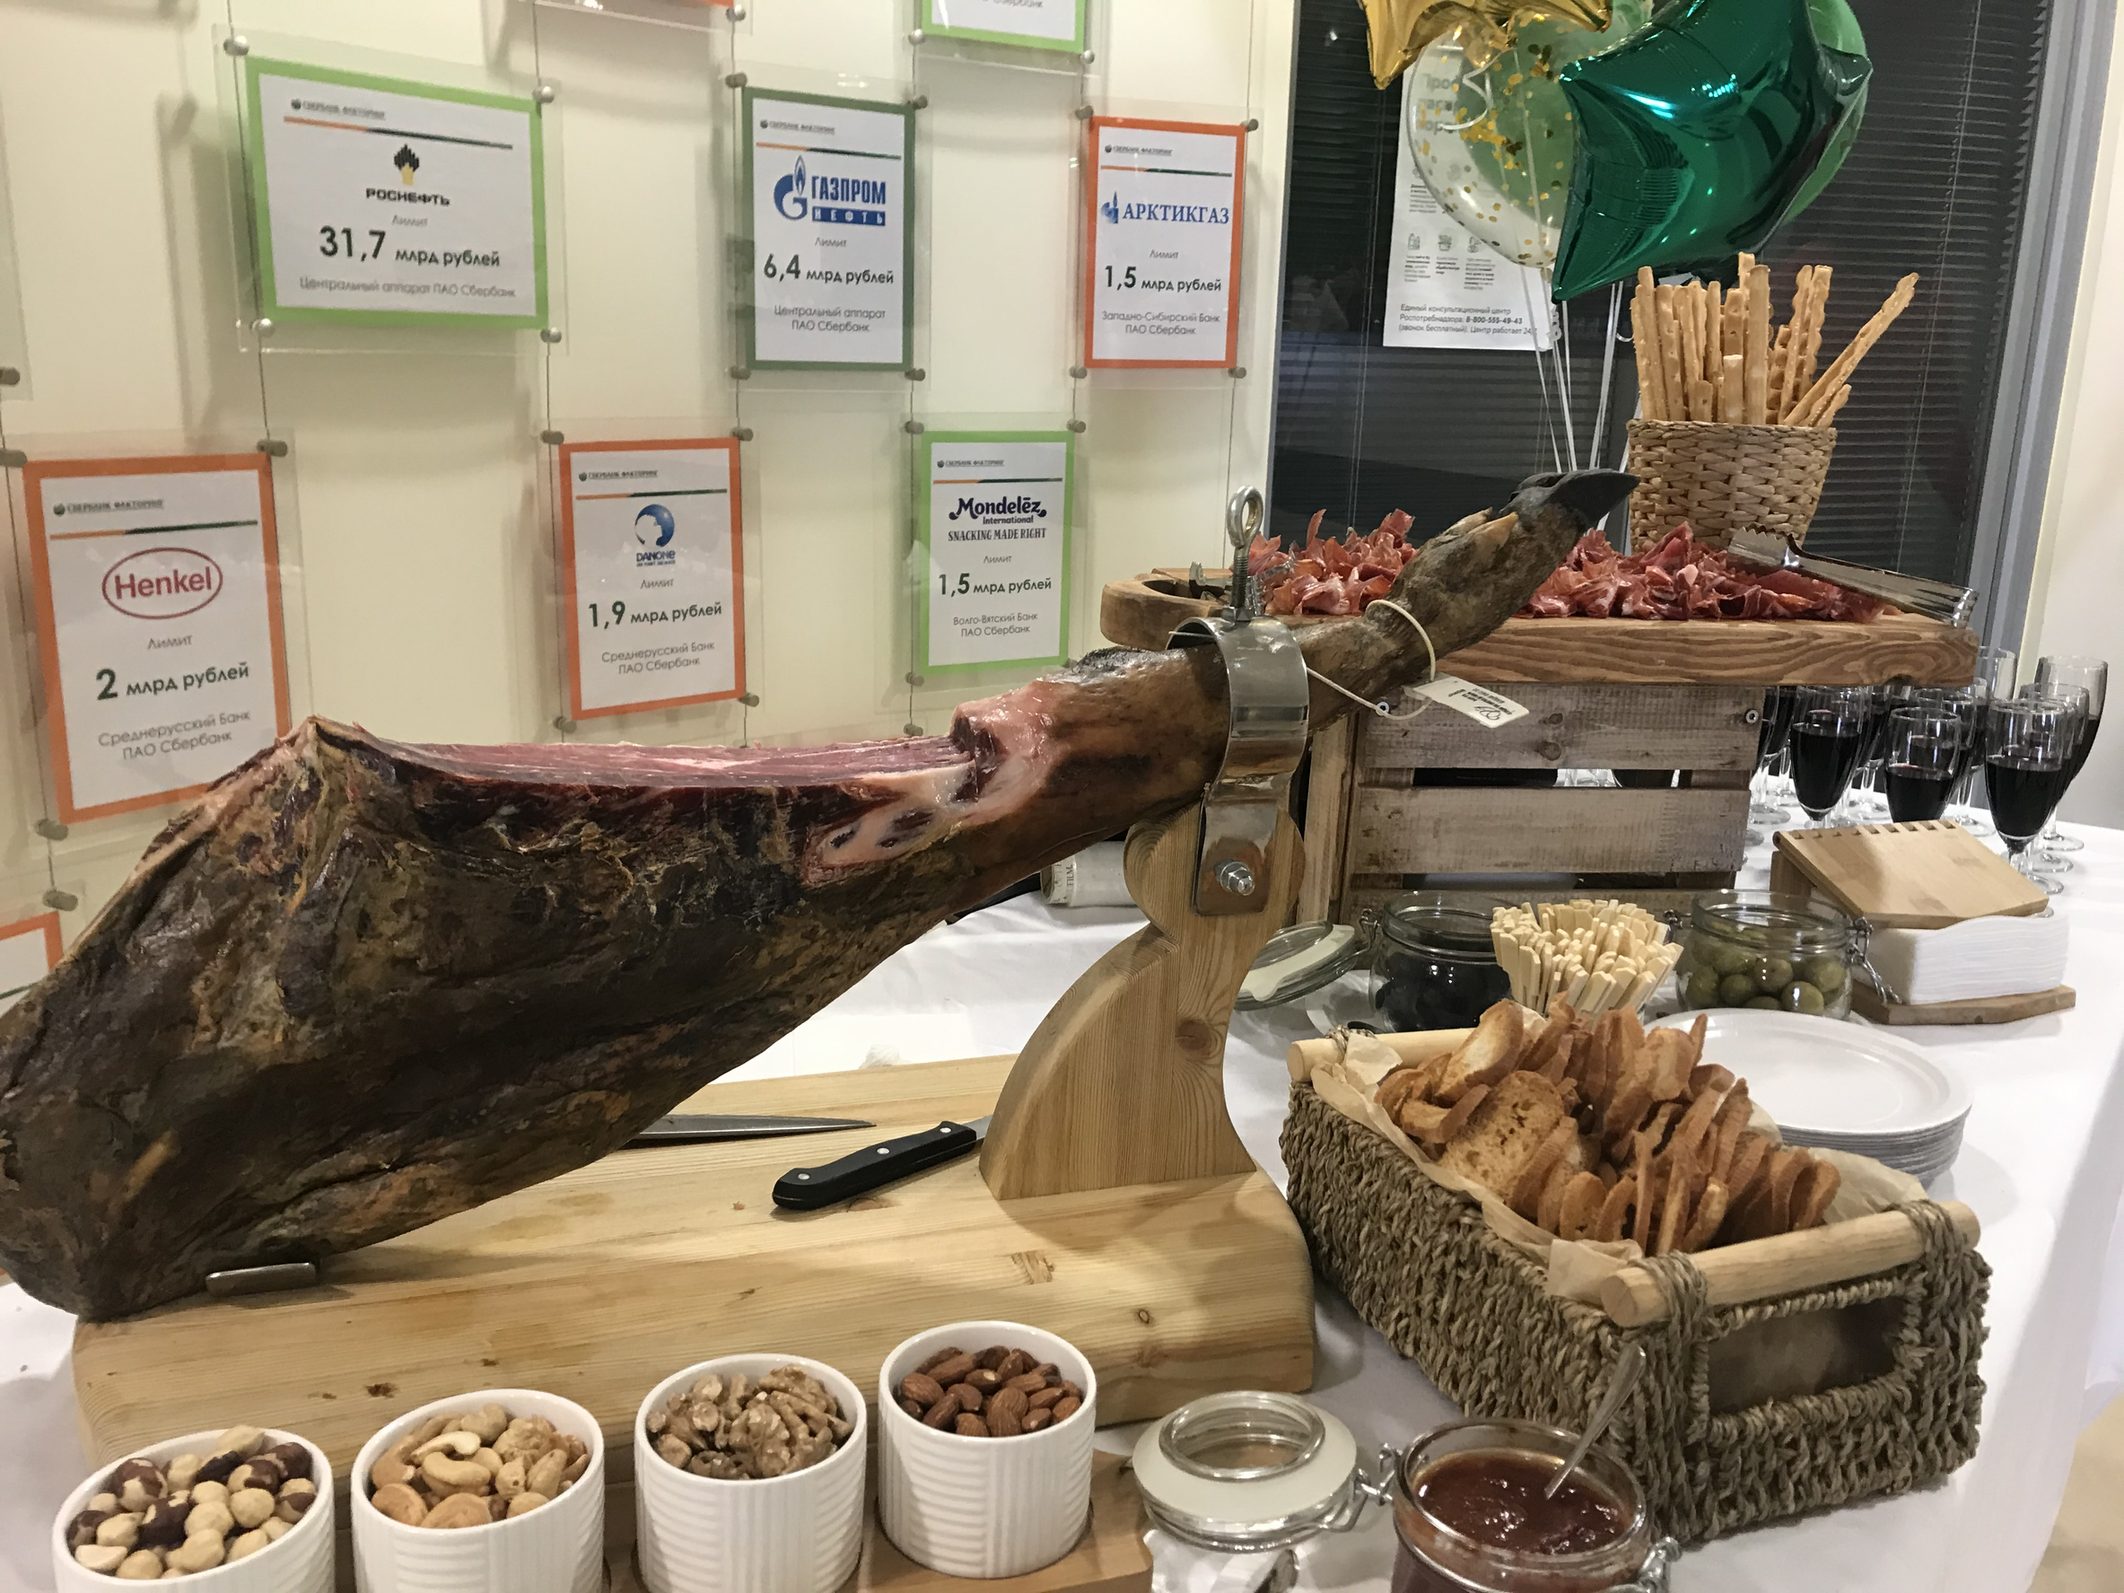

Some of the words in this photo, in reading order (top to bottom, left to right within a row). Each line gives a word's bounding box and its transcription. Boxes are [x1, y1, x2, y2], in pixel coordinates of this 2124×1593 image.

[366, 188, 450, 206] РОСНЕФТЬ
[811, 175, 886, 205] ГАЗПРОМ
[392, 214, 428, 228] Лимит
[813, 208, 884, 225] НЕФТЬ
[1122, 203, 1230, 225] АРКТИКГАЗ
[319, 224, 387, 263] 31,7
[395, 249, 440, 266] млрд
[443, 249, 501, 269] рублей
[814, 236, 848, 248] Лимит
[1149, 249, 1180, 261] Лимит
[763, 253, 802, 283] 6,4
[806, 268, 843, 284] млрд
[846, 268, 894, 286] рублей
[299, 275, 380, 293] Центральный
[382, 281, 432, 297] аппарат
[433, 282, 459, 296] ПАО
[461, 283, 516, 299] Сбербанк
[1104, 264, 1138, 292] 1,5
[1141, 278, 1174, 293] млрд
[1177, 277, 1222, 294] рублей
[774, 303, 842, 319] Центральный
[843, 308, 886, 321] аппарат
[1101, 309, 1198, 325] Западно-Сибирский
[1199, 311, 1221, 323] Банк
[1400, 303, 1427, 313] Единый
[791, 319, 816, 332] ПАО
[817, 320, 871, 334] Сбербанк
[1125, 324, 1148, 336] ПАО
[1149, 324, 1197, 337] Сбербанк
[982, 514, 1034, 526] International
[948, 529, 993, 543] SNACKING
[994, 528, 1020, 541] MADE
[1020, 527, 1046, 540] RIGHT
[983, 554, 1013, 565] Лимит
[114, 566, 213, 600] Henkel
[640, 578, 674, 590] Лимит
[938, 572, 971, 598] 1,5
[973, 581, 1006, 596] млрд
[1008, 576, 1052, 594] рублей
[588, 600, 627, 630] 1,9
[630, 609, 669, 626] млрд
[672, 601, 722, 622] рублей
[953, 611, 1016, 626] Волго-Вятский
[1017, 610, 1038, 622] Банк
[961, 626, 983, 638] ПАО
[984, 624, 1031, 637] Сбербанк
[147, 634, 194, 650] Лимит
[601, 641, 689, 664] Среднерусский
[690, 640, 715, 653] Банк
[618, 662, 644, 675] ПАО
[646, 655, 700, 672] Сбербанк
[96, 668, 119, 700] 2
[126, 678, 179, 698] млрд
[183, 661, 250, 692] рублей
[98, 714, 217, 748] Среднерусский
[219, 708, 251, 726] Банк
[122, 744, 157, 762] ПАО
[159, 729, 233, 757] Сбербанк
